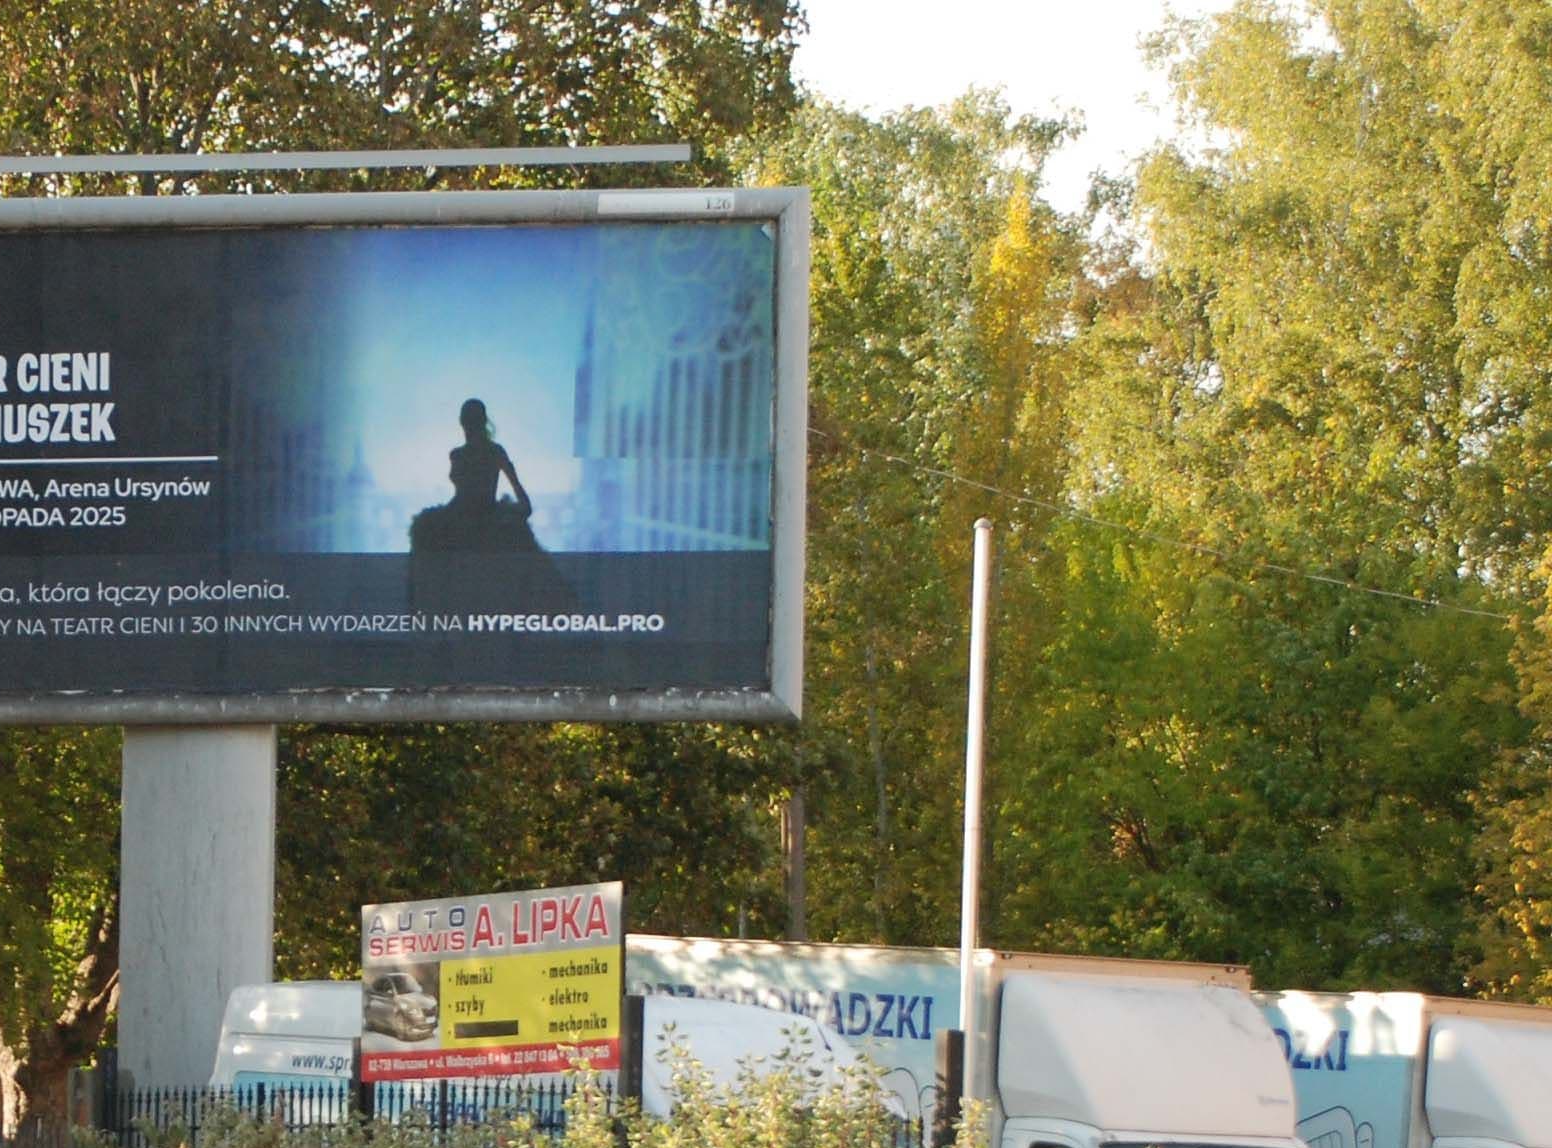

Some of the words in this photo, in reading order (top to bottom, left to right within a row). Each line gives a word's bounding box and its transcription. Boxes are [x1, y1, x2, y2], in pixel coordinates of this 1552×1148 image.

[17, 352, 111, 393] CIENI
[44, 479, 110, 498] Arena
[114, 476, 211, 501] Ursynów
[70, 506, 126, 526] 2025
[28, 582, 89, 603] która
[98, 581, 162, 607] łączy
[168, 578, 290, 606] pokolenia.
[17, 618, 46, 635] NA
[51, 617, 115, 635] TEATR
[120, 616, 174, 634] CIENI
[179, 616, 185, 633] I
[191, 615, 218, 633] 30
[224, 615, 303, 633] INNYCH
[308, 610, 426, 633] WYDARZEŃ
[433, 615, 463, 632] NA
[468, 613, 665, 633] HYPEGLOBAL.PRO
[369, 907, 466, 934] AUTO
[472, 903, 503, 949] A.
[511, 893, 610, 946] LIPKA
[369, 930, 466, 958] SERWIS
[454, 966, 494, 987] tłumiki
[548, 956, 609, 979] mechanika
[454, 997, 486, 1014] szyby
[548, 988, 589, 1006] elektro
[548, 1014, 608, 1034] mechanika
[291, 1053, 352, 1074] www.spr
